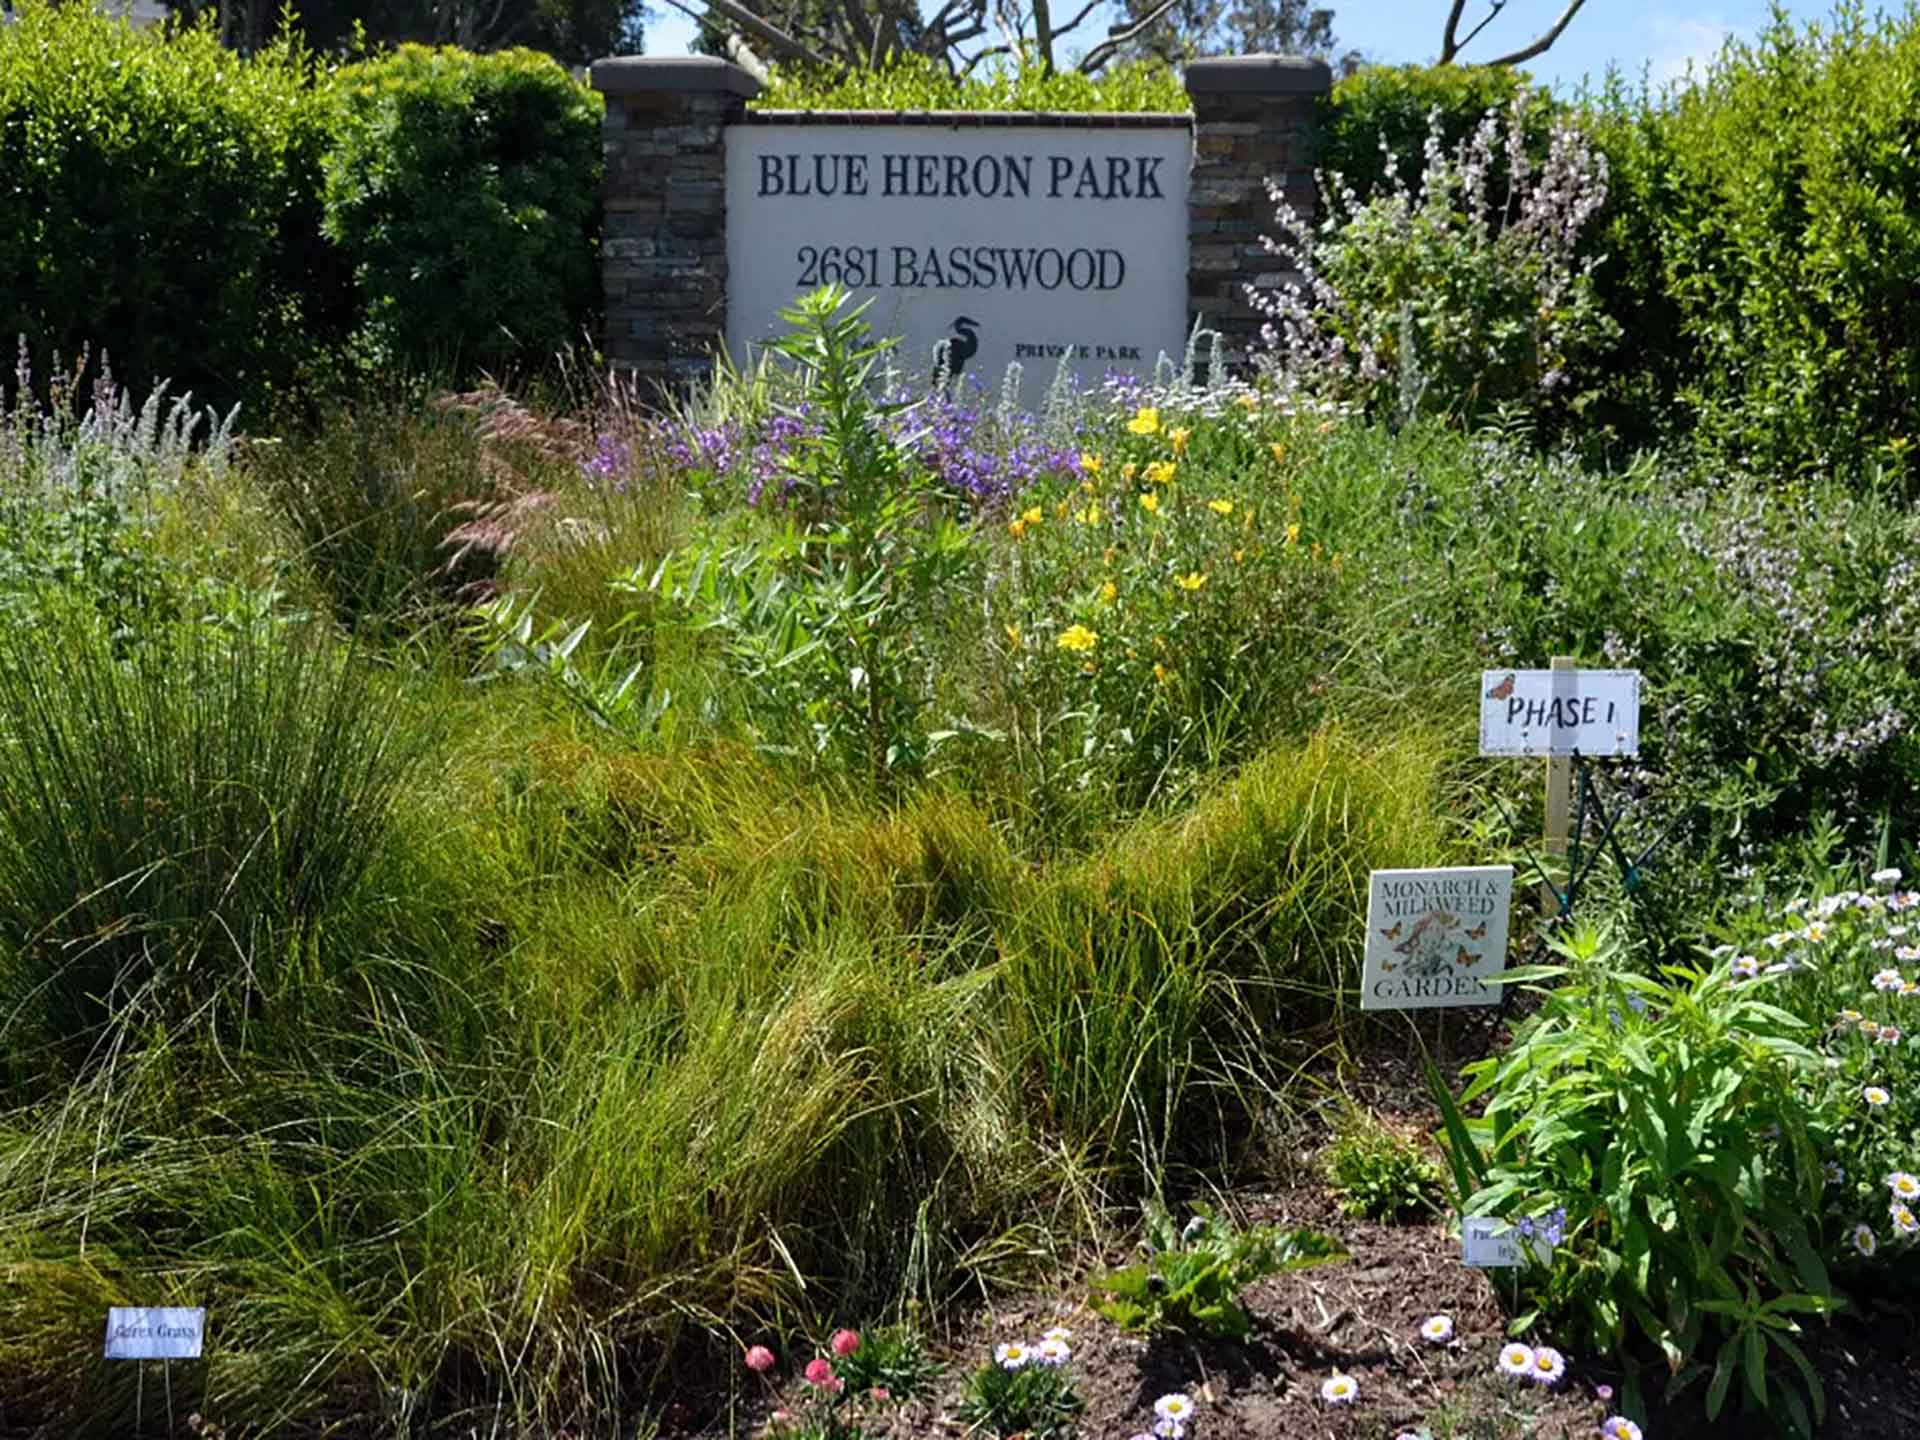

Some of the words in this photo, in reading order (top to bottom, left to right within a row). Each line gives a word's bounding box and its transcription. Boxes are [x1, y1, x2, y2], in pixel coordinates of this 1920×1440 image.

[757, 154, 868, 197] BLUE
[881, 154, 1033, 198] HERON
[1048, 156, 1165, 199] PARK
[796, 246, 883, 288] 2681
[889, 246, 1126, 290] BASSWOOD
[1095, 345, 1141, 359] PARK
[1506, 697, 1598, 728] PHASE
[1381, 879, 1480, 899] MONARCH
[1485, 879, 1500, 896] &
[1383, 896, 1496, 918] MILKWEED
[1373, 975, 1488, 999] GARDEN
